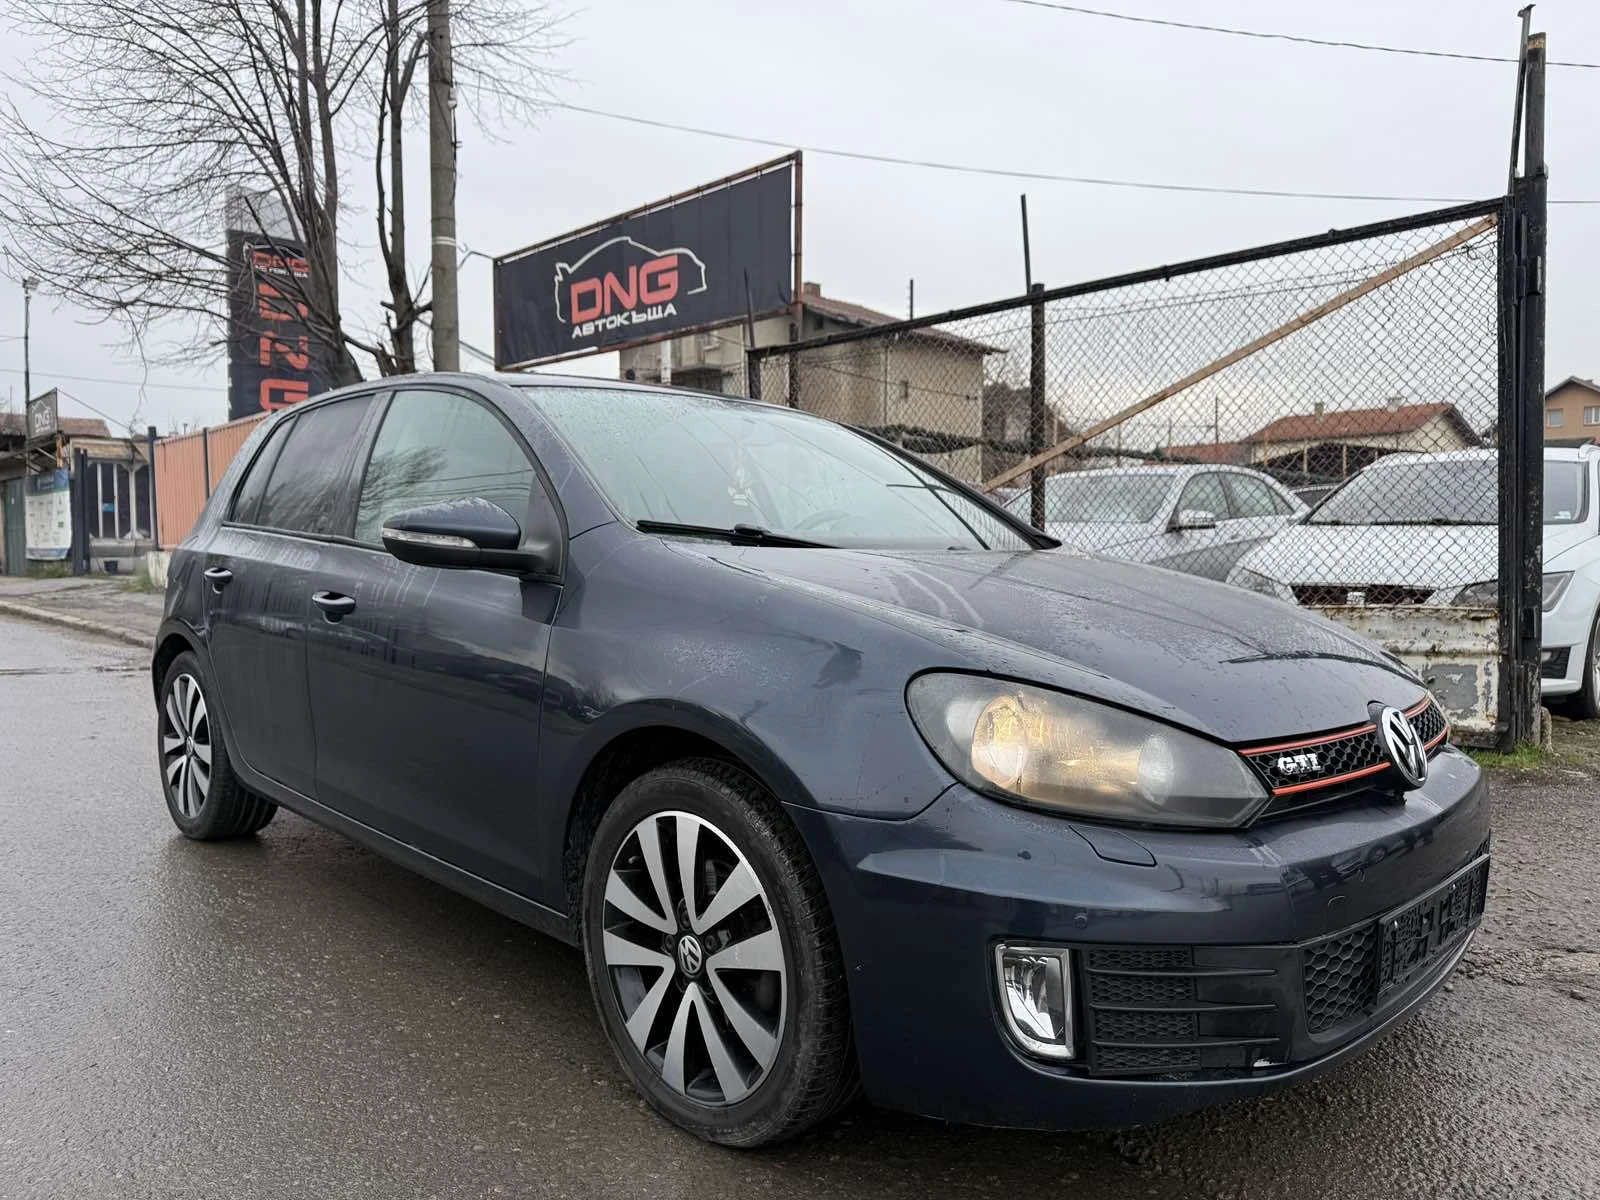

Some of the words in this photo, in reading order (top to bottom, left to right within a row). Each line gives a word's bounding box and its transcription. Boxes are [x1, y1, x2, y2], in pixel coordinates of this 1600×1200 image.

[571, 255, 678, 325] DNG
[572, 303, 677, 339] АВТОКЪША
[1277, 753, 1321, 775] GTI
